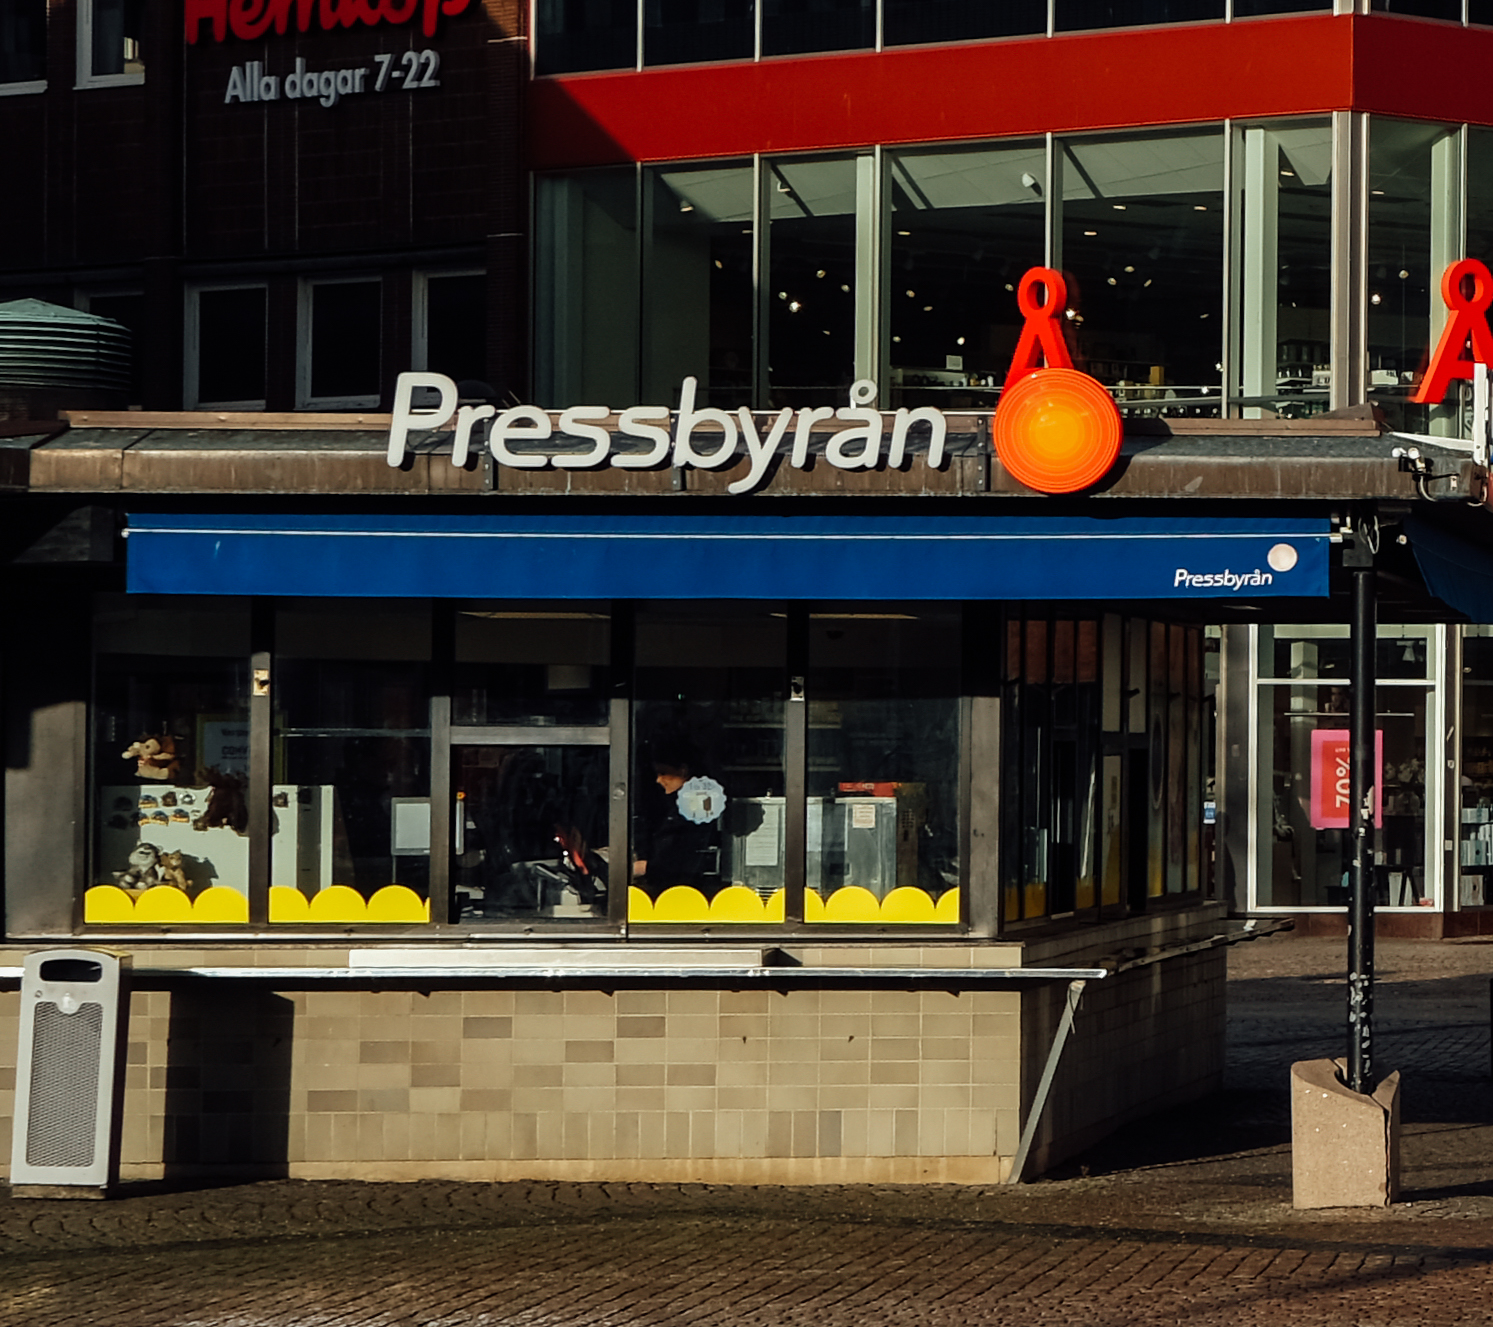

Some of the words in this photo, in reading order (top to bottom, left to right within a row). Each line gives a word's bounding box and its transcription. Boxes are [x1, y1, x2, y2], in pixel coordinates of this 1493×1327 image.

[224, 60, 281, 104] Alla
[284, 57, 370, 107] dagar
[374, 49, 441, 92] 7-22
[387, 371, 948, 494] Pressbyrån
[1173, 568, 1273, 591] Pressbyrån
